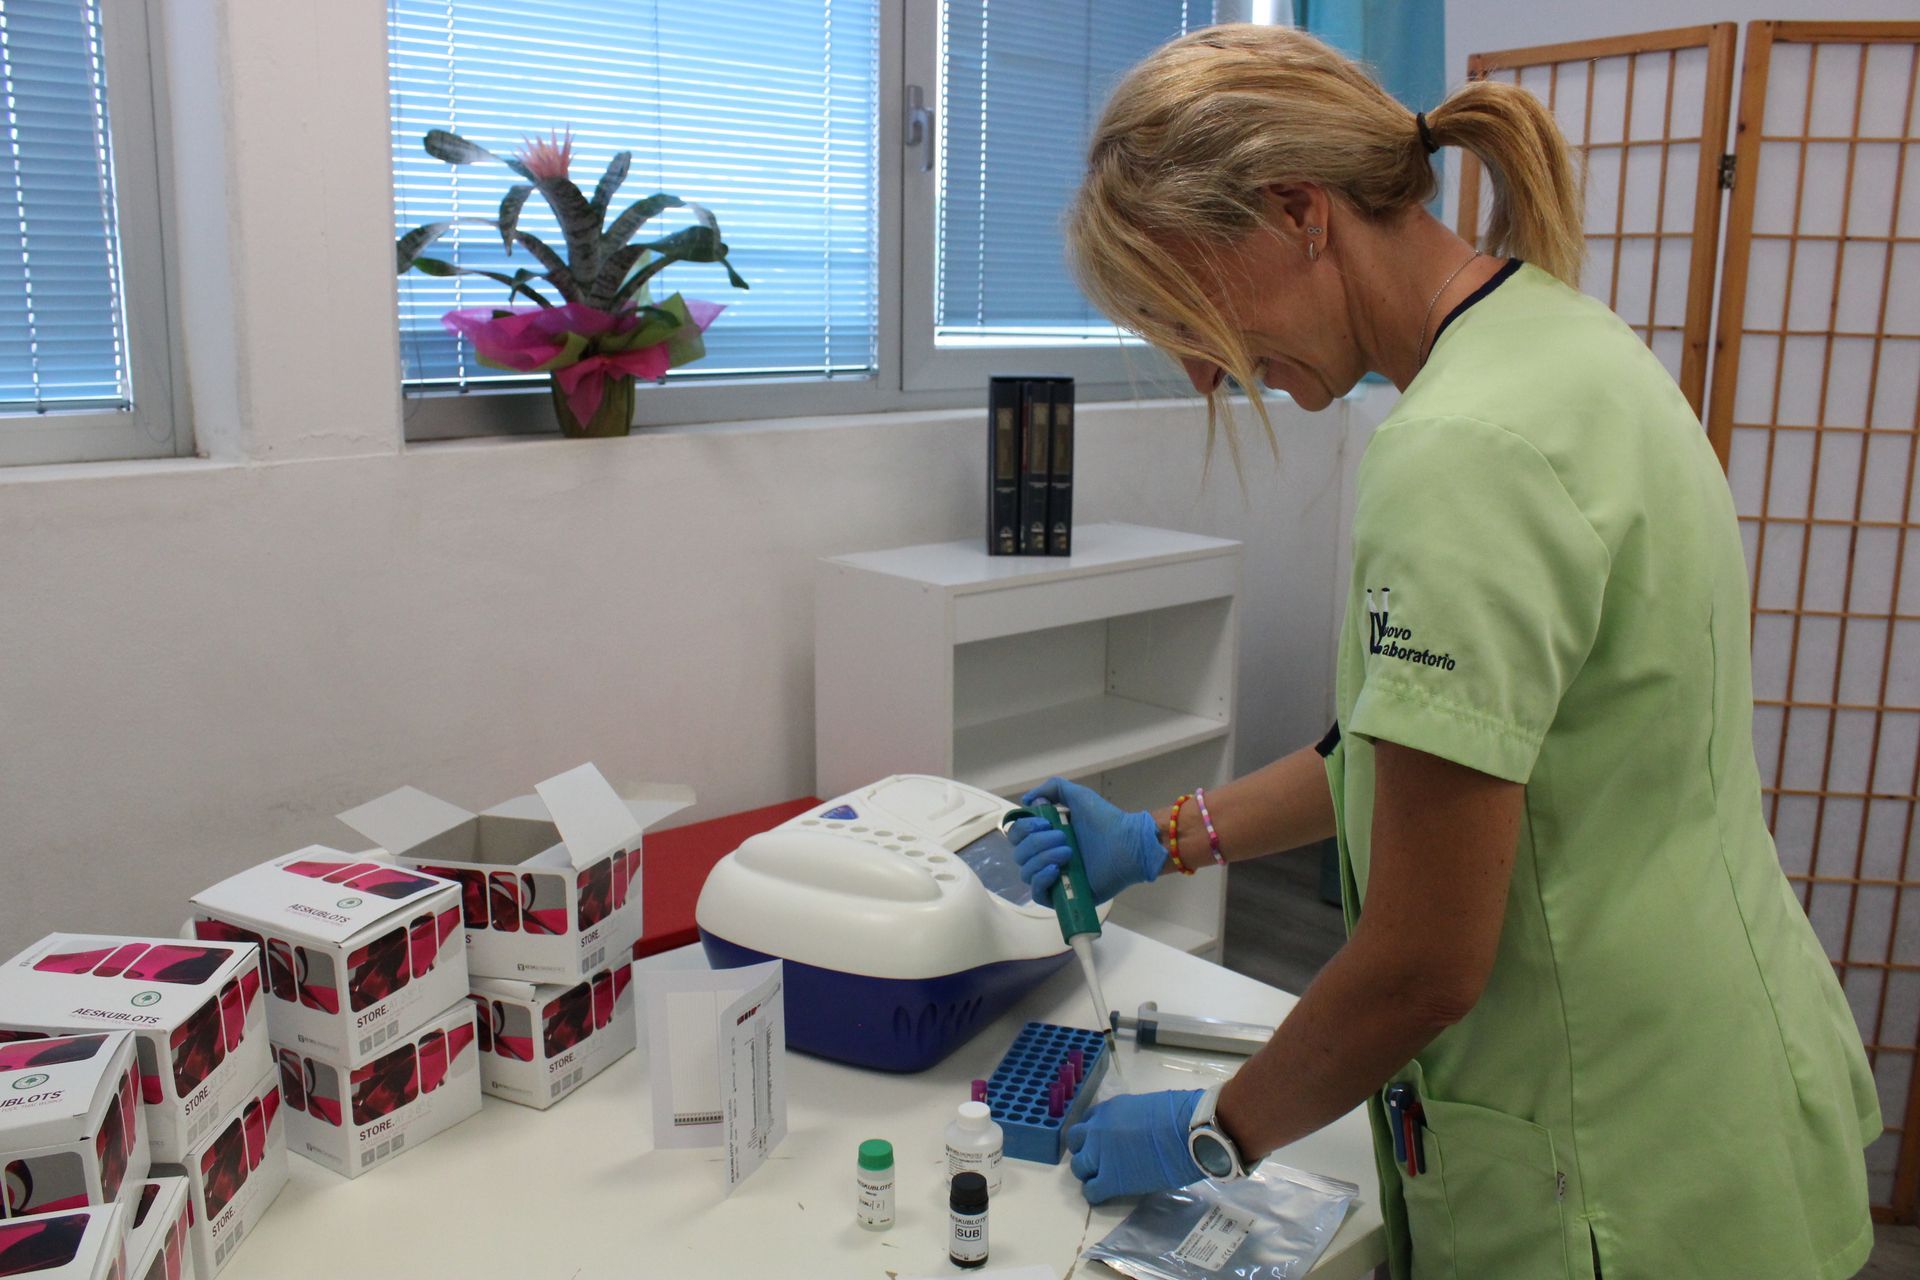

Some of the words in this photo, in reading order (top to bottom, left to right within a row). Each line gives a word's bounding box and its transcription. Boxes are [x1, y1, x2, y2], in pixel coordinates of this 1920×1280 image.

[1369, 639, 1456, 671] Laboratorio
[289, 903, 351, 924] AESKUBLOTS
[72, 1007, 160, 1025] AESKUBLOTS
[359, 1118, 396, 1142] STORE.
[957, 1228, 980, 1239] SUB
